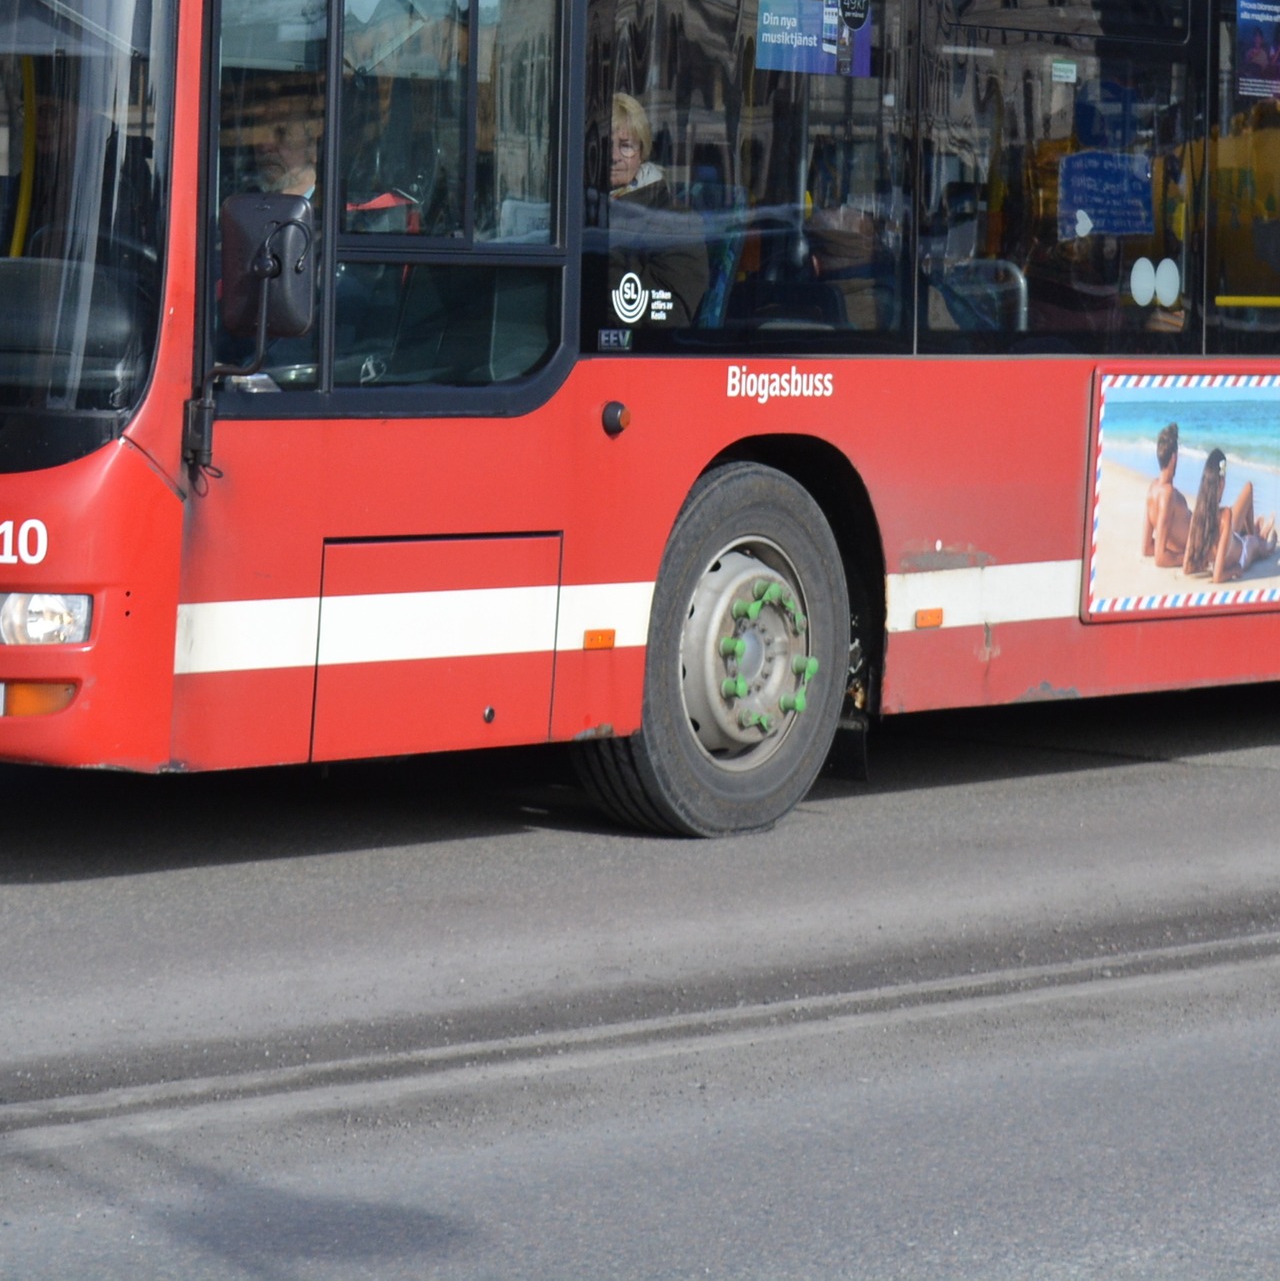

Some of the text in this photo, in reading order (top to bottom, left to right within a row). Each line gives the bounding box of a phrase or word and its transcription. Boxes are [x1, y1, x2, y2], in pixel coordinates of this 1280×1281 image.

[763, 12, 797, 30] Din nya
[761, 32, 818, 48] musiktjänst
[623, 282, 638, 300] SL
[601, 330, 631, 347] EEV
[726, 365, 834, 404] Biogasbuss
